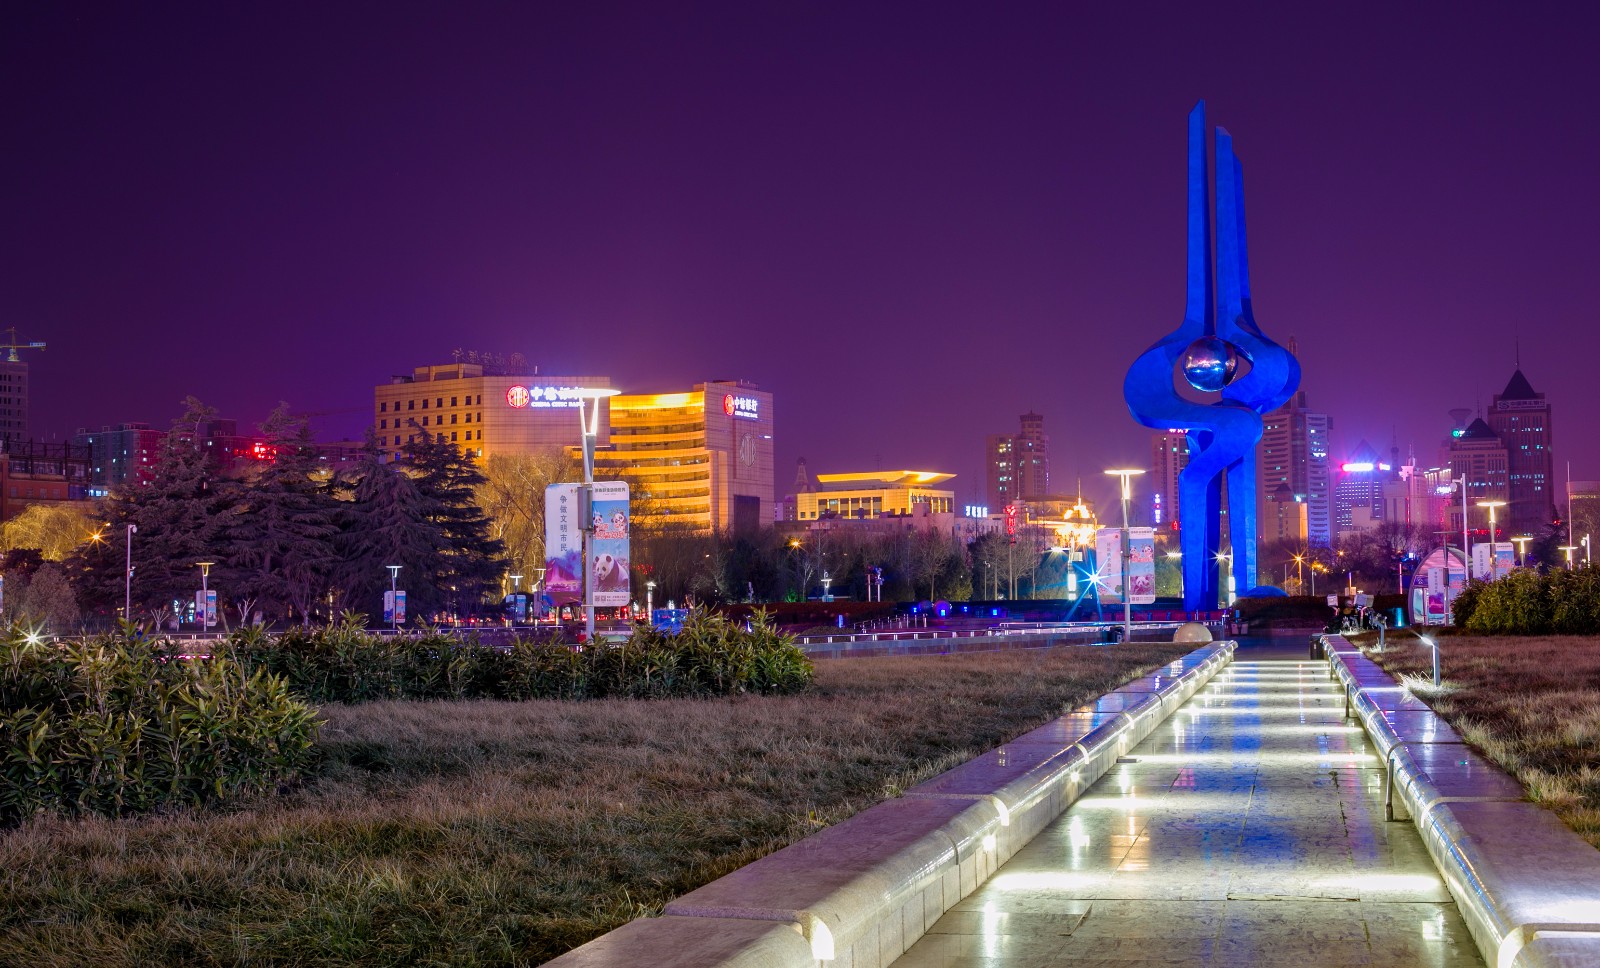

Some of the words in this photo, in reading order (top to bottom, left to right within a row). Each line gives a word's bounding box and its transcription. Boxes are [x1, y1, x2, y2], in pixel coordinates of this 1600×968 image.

[559, 494, 568, 552] 争做文明市民
